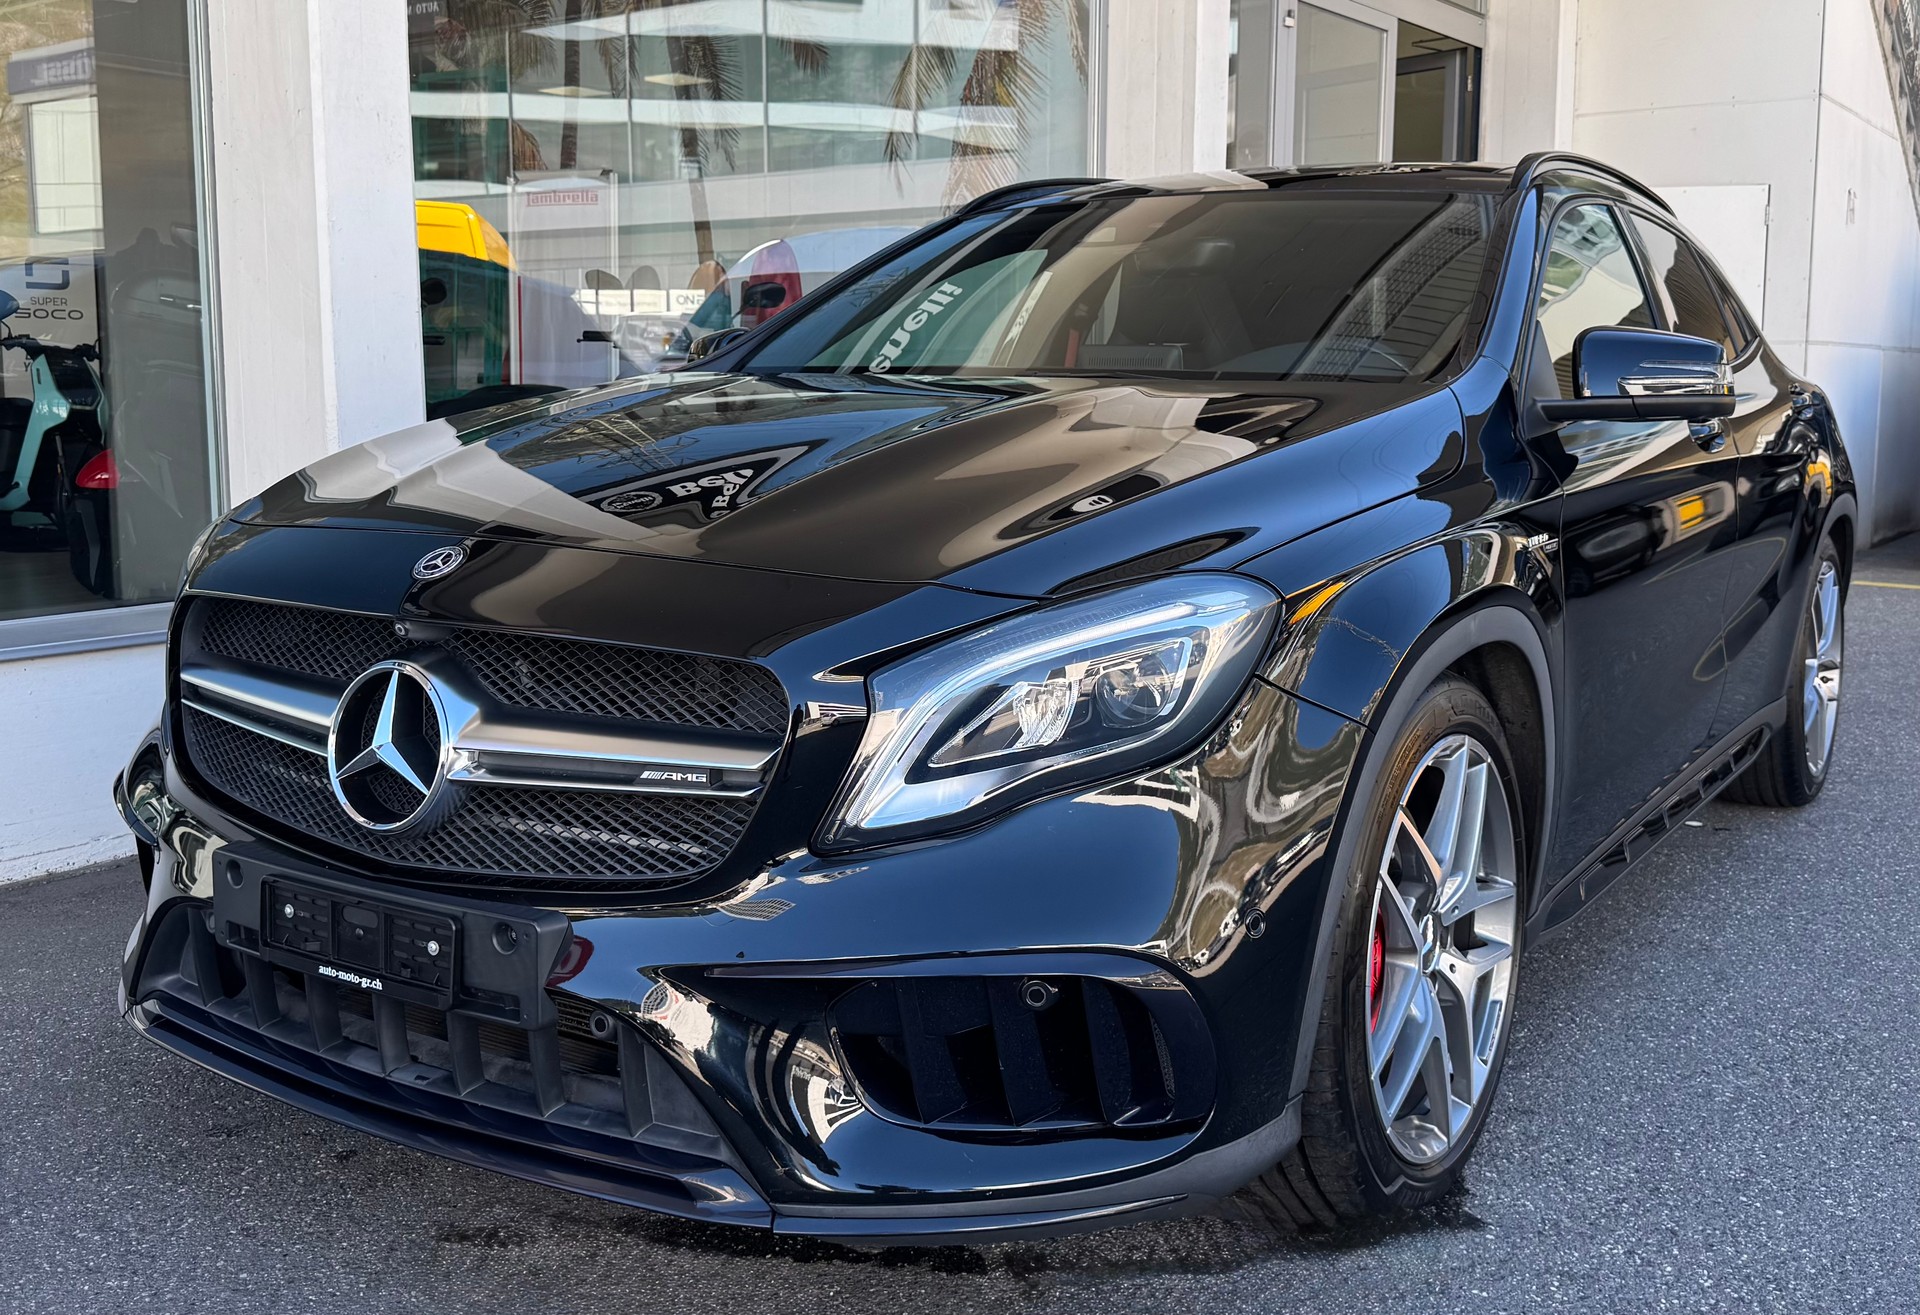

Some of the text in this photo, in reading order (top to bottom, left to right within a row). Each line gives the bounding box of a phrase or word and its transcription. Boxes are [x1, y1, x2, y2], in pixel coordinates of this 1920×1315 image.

[30, 296, 68, 306] SUPER
[15, 308, 84, 320] SOCO
[318, 965, 383, 990] auto-moto-gr.ch
